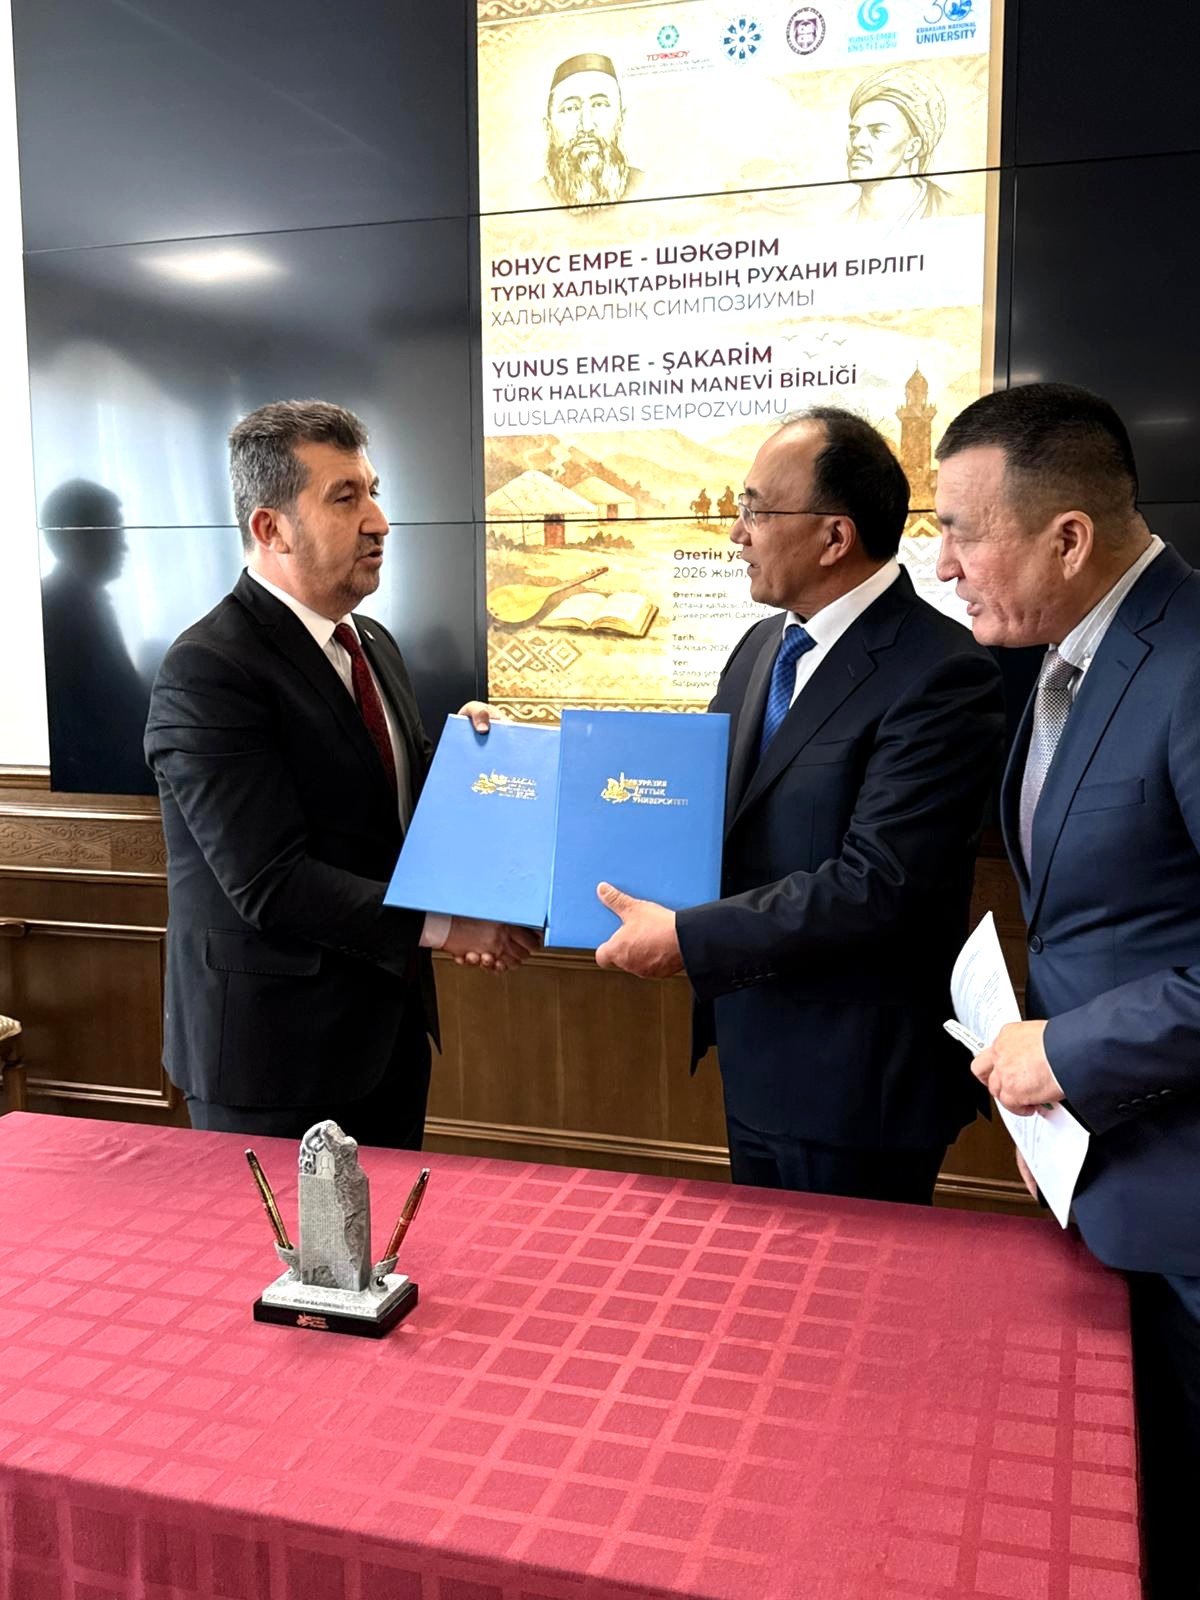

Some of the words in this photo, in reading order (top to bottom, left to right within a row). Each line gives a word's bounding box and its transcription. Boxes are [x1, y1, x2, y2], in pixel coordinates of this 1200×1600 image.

[916, 28, 976, 44] UNIVERSITY
[491, 255, 561, 278] ЮНУС
[569, 250, 633, 272] ЕМРЕ
[656, 238, 779, 265] ШӘКӘРІМ
[491, 283, 545, 302] ТҮРКІ
[552, 268, 741, 299] ХАЛЫҚТАРЫНЫҢ
[747, 261, 837, 284] РУХАНИ
[845, 254, 924, 276] БІРЛІГІ
[491, 301, 648, 327] ХАЛЫҚАРАЛЫҚ
[653, 289, 814, 317] СИМПОЗИУМЫ
[492, 358, 569, 379] YUNUS
[576, 354, 641, 374] EMRE
[662, 342, 772, 375] ŞAKARİM
[493, 384, 543, 403] TÜRK
[549, 378, 683, 401] HALKLARININ
[691, 369, 772, 393] MANEVİ
[780, 364, 857, 388] BİRLİĞİ
[493, 405, 635, 427] ULUSLARARASI
[640, 398, 788, 421] SEMPOZYUMU
[673, 547, 722, 560] Өтетін
[727, 550, 744, 562] уа
[673, 566, 707, 578] 2026
[711, 568, 748, 579] жыл,
